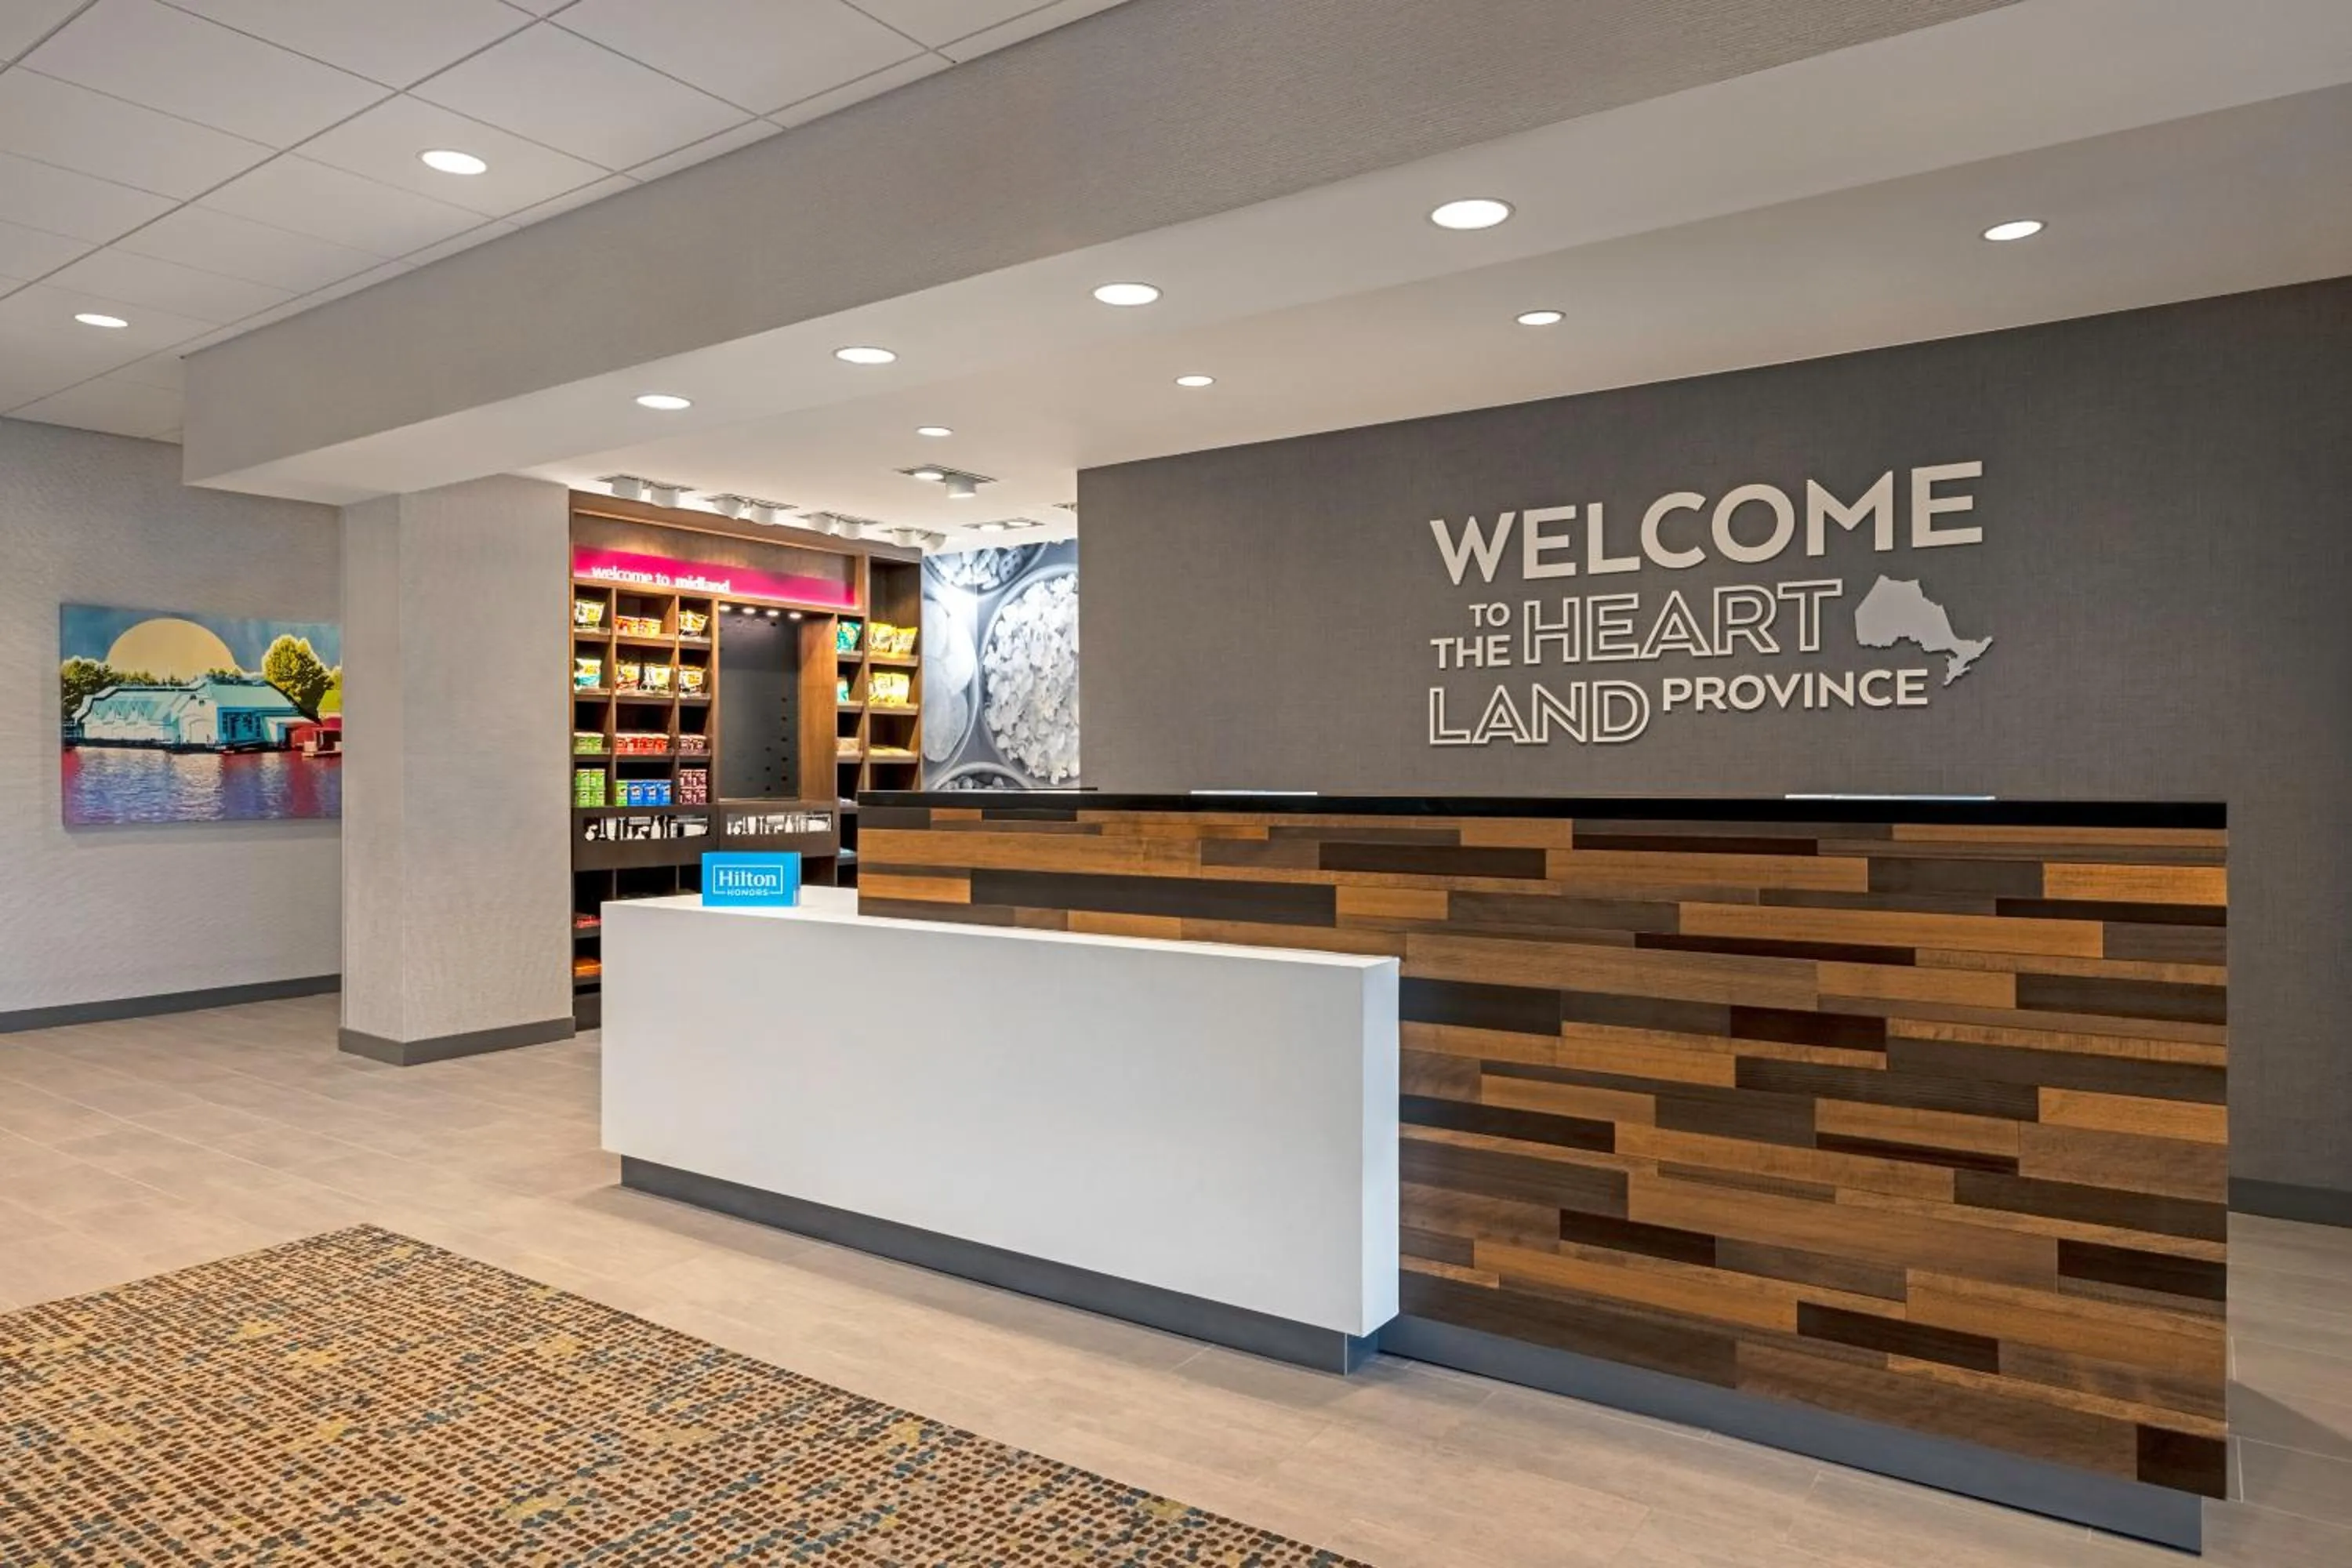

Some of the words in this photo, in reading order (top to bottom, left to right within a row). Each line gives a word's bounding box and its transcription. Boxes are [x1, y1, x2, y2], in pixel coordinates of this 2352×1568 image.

[1429, 460, 1983, 586] WELCOME
[591, 565, 652, 583] welcome
[655, 573, 670, 586] to
[675, 575, 731, 593] midland
[1431, 634, 1511, 669] THE
[1523, 579, 1842, 665] HEART
[1469, 602, 1511, 627] TO
[1429, 680, 1650, 745] LAND
[1663, 669, 1928, 711] PROVINCE
[719, 869, 778, 887] Hilton
[727, 888, 768, 897] HONORS
